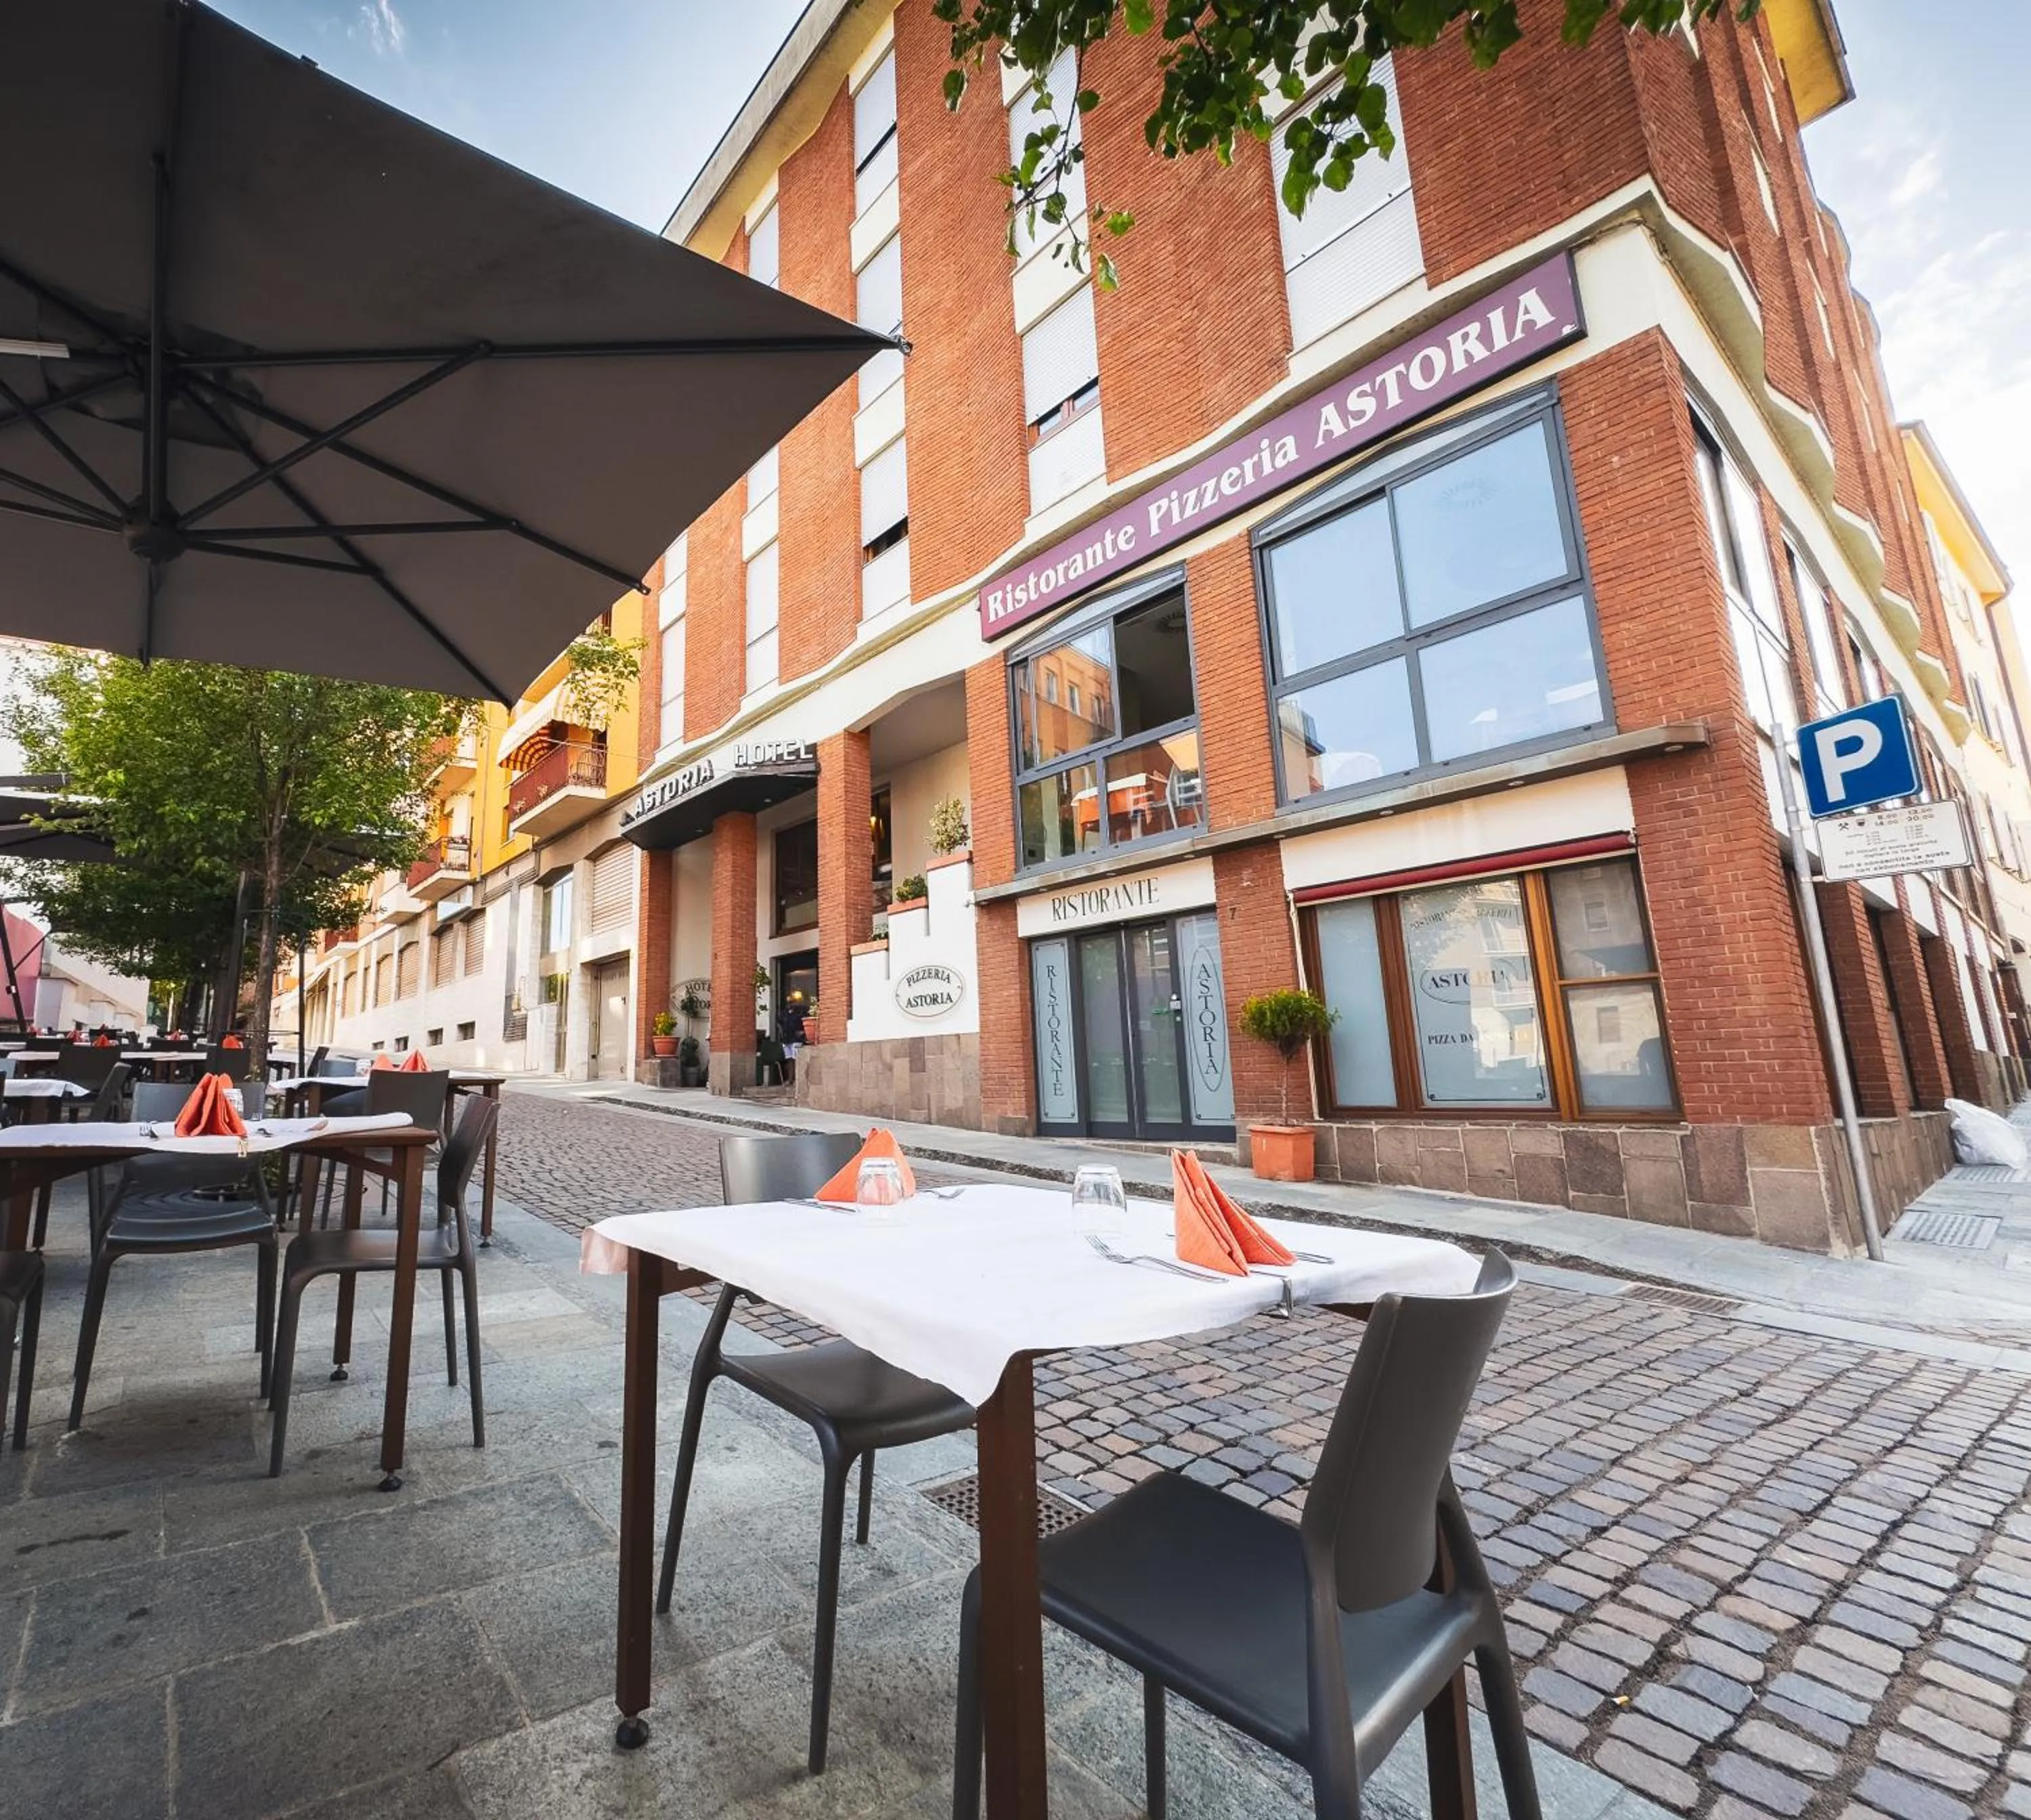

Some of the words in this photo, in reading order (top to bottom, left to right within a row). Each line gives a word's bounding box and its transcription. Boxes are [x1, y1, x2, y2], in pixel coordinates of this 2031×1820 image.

[986, 522, 1137, 625] Ristorante
[1148, 434, 1300, 538] Pizzeria
[1314, 286, 1556, 449] ASTORIA
[1814, 718, 1883, 804] P
[633, 759, 715, 819] ASTORIA
[733, 738, 813, 768] HOTEL
[1050, 877, 1160, 923] RISTORANTE
[1227, 907, 1237, 920] 7
[685, 980, 710, 995] HOT
[906, 968, 951, 987] PIZZERIA
[1429, 969, 1510, 991] ASTOIA
[905, 991, 953, 1008] ASTORIA
[1045, 963, 1064, 1097] RISTORANTE
[1197, 963, 1219, 1075] ASTORIA
[1427, 1033, 1457, 1045] PIZZA
